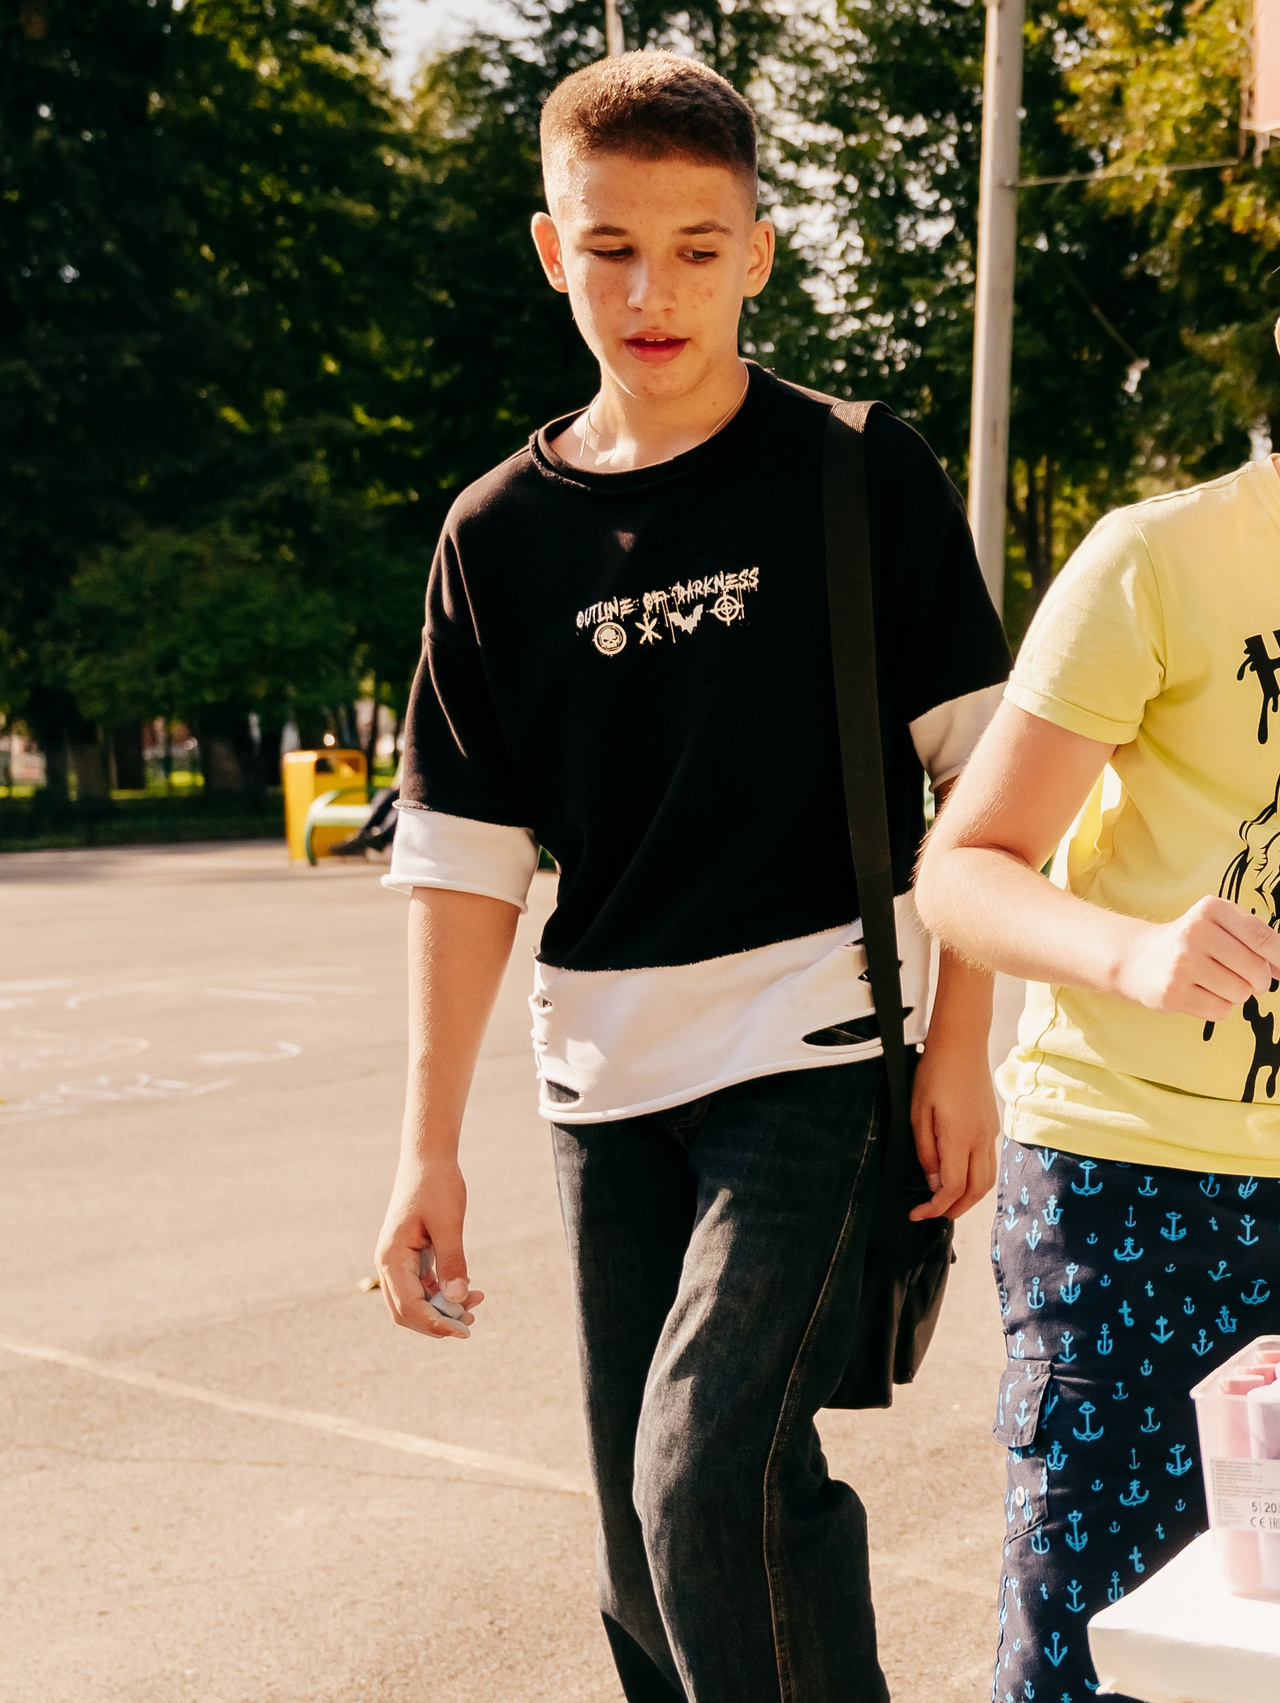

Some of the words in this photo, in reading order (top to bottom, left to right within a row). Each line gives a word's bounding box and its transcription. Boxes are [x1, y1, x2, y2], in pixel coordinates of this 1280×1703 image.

[576, 596, 637, 629] OUTLINE
[672, 566, 760, 603] DARKNESS
[1251, 1501, 1258, 1513] 5
[1264, 1502, 1277, 1514] 20
